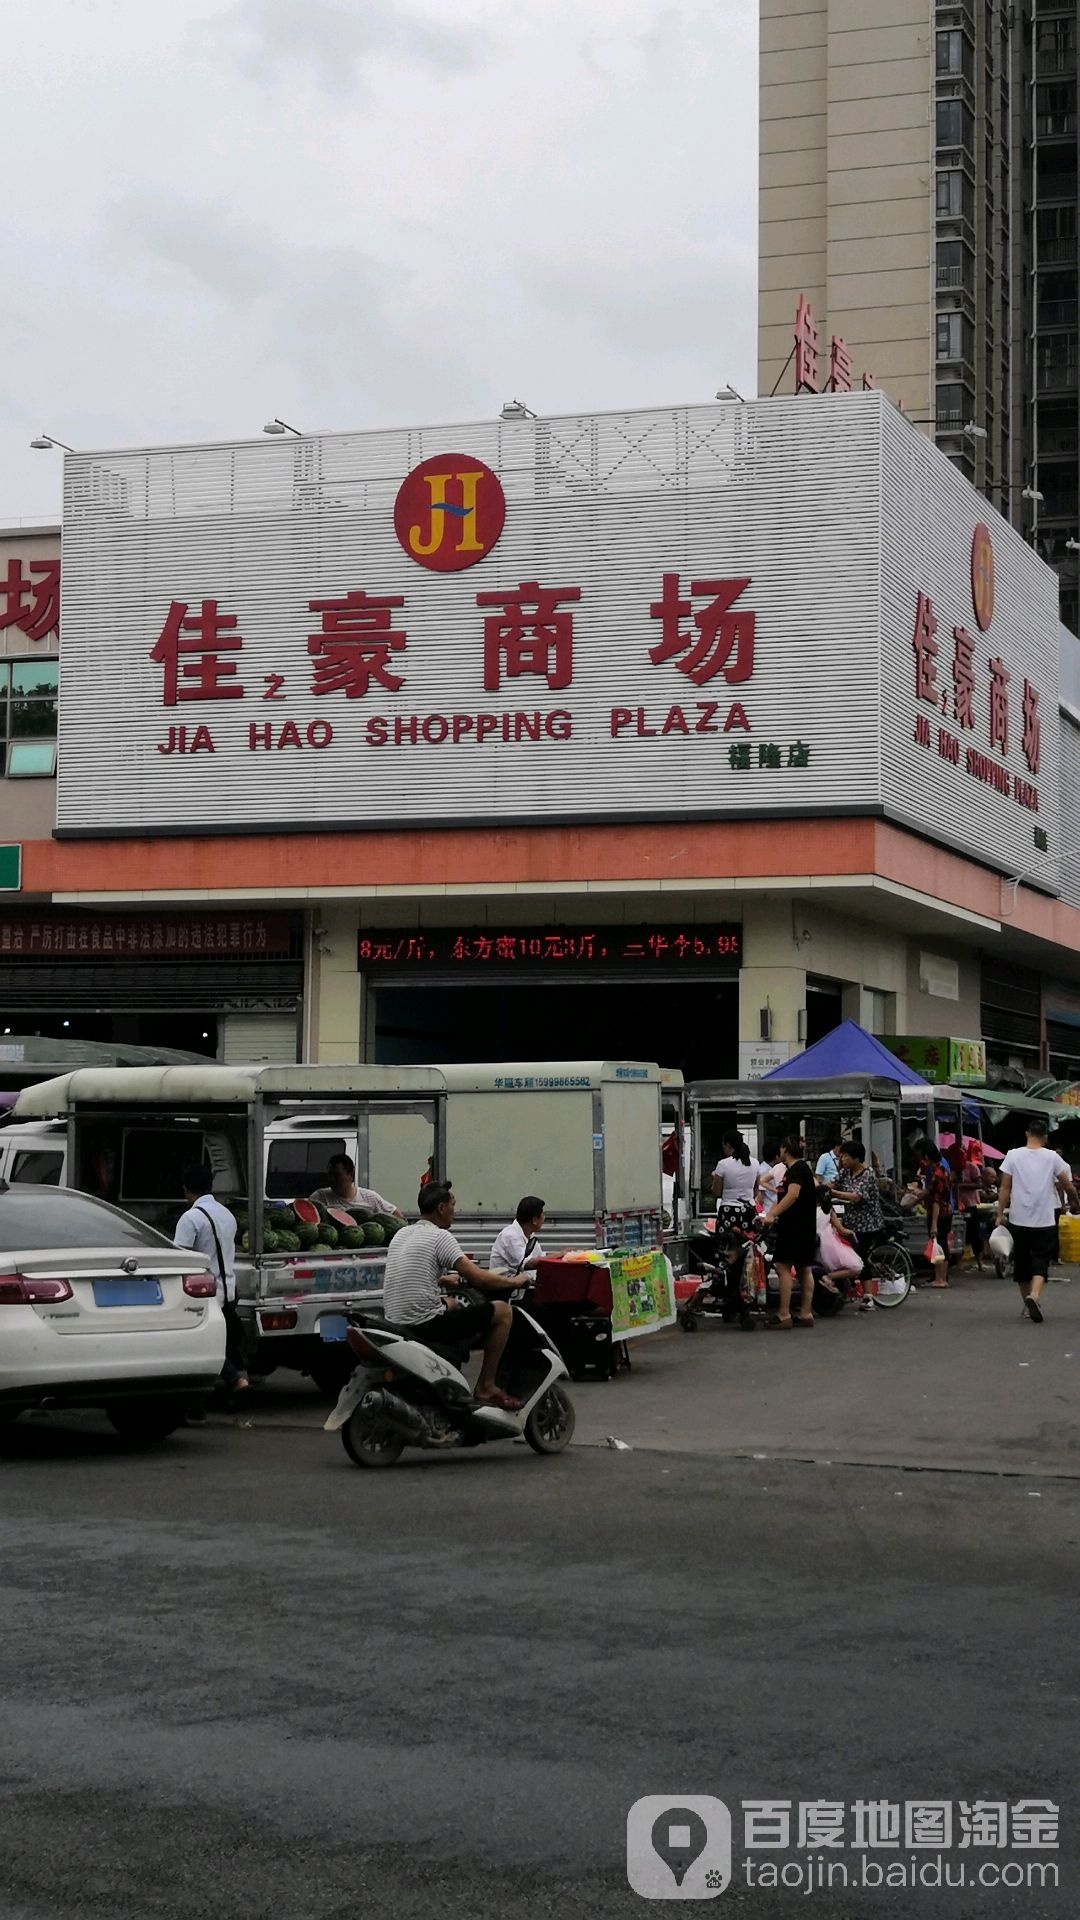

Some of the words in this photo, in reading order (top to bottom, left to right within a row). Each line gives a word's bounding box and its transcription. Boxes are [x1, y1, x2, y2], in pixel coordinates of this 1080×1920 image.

[158, 725, 215, 754] JIA
[248, 720, 333, 749] HAO
[366, 709, 572, 745] SHOPPING
[611, 702, 750, 736] PLAZA
[938, 727, 960, 765] HAO
[1014, 771, 1039, 812] PLAZA
